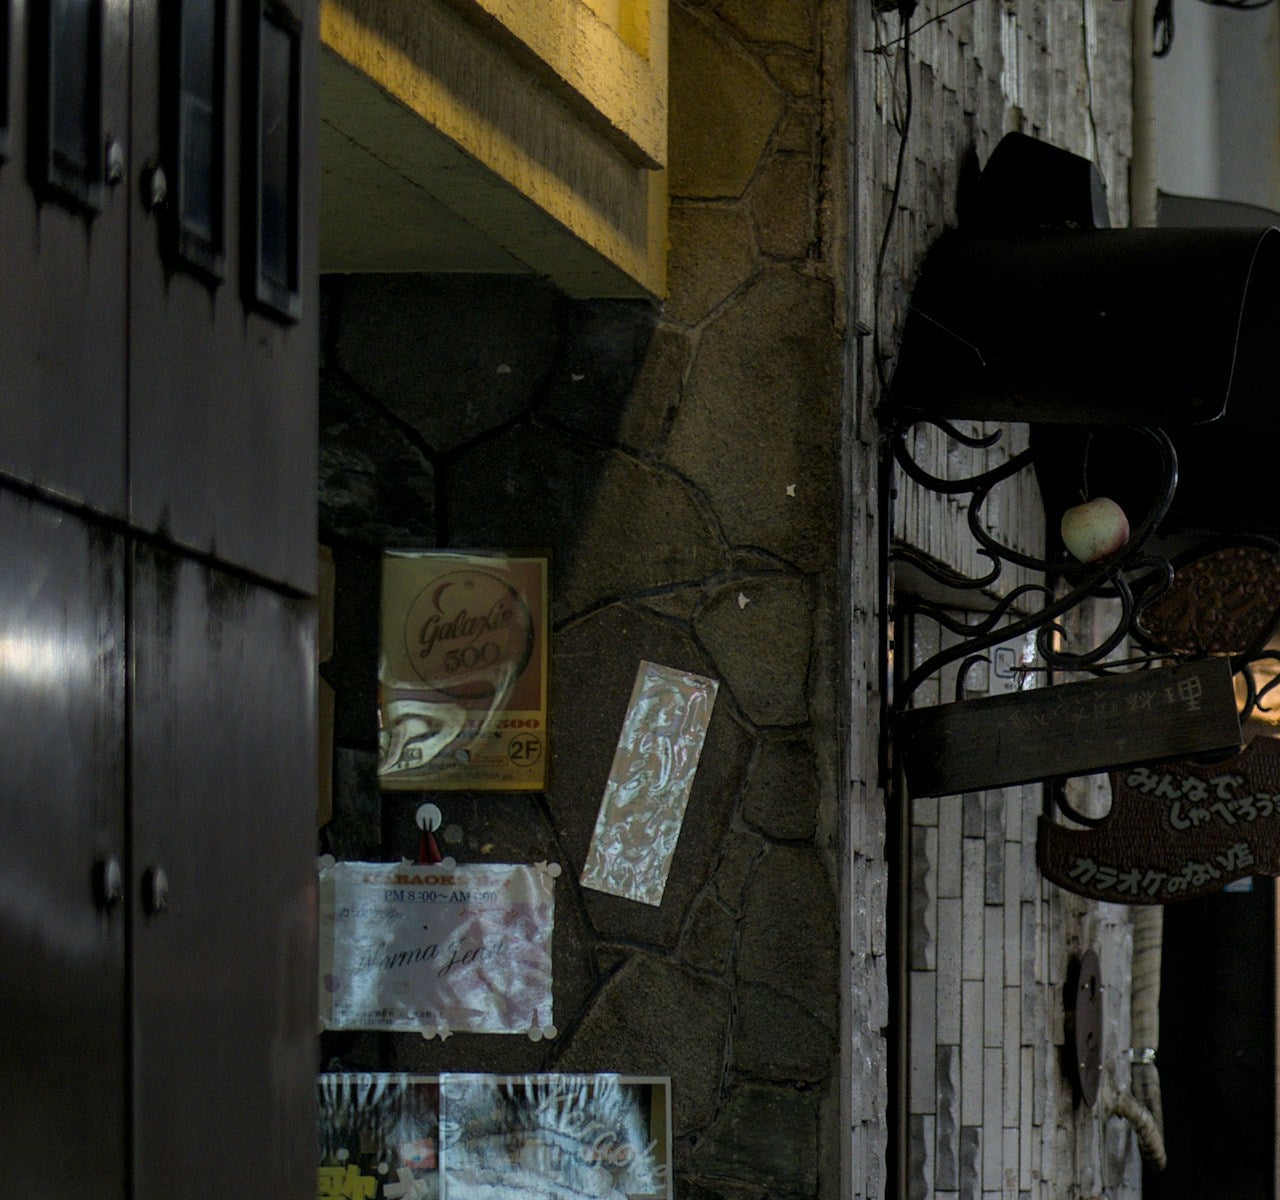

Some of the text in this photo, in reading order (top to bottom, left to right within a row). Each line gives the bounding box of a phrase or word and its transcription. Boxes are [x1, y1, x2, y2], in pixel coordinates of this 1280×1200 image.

[419, 599, 514, 659] Galaxie
[445, 641, 501, 672] 500
[511, 740, 540, 760] 2F
[1126, 766, 1245, 803] みんなで
